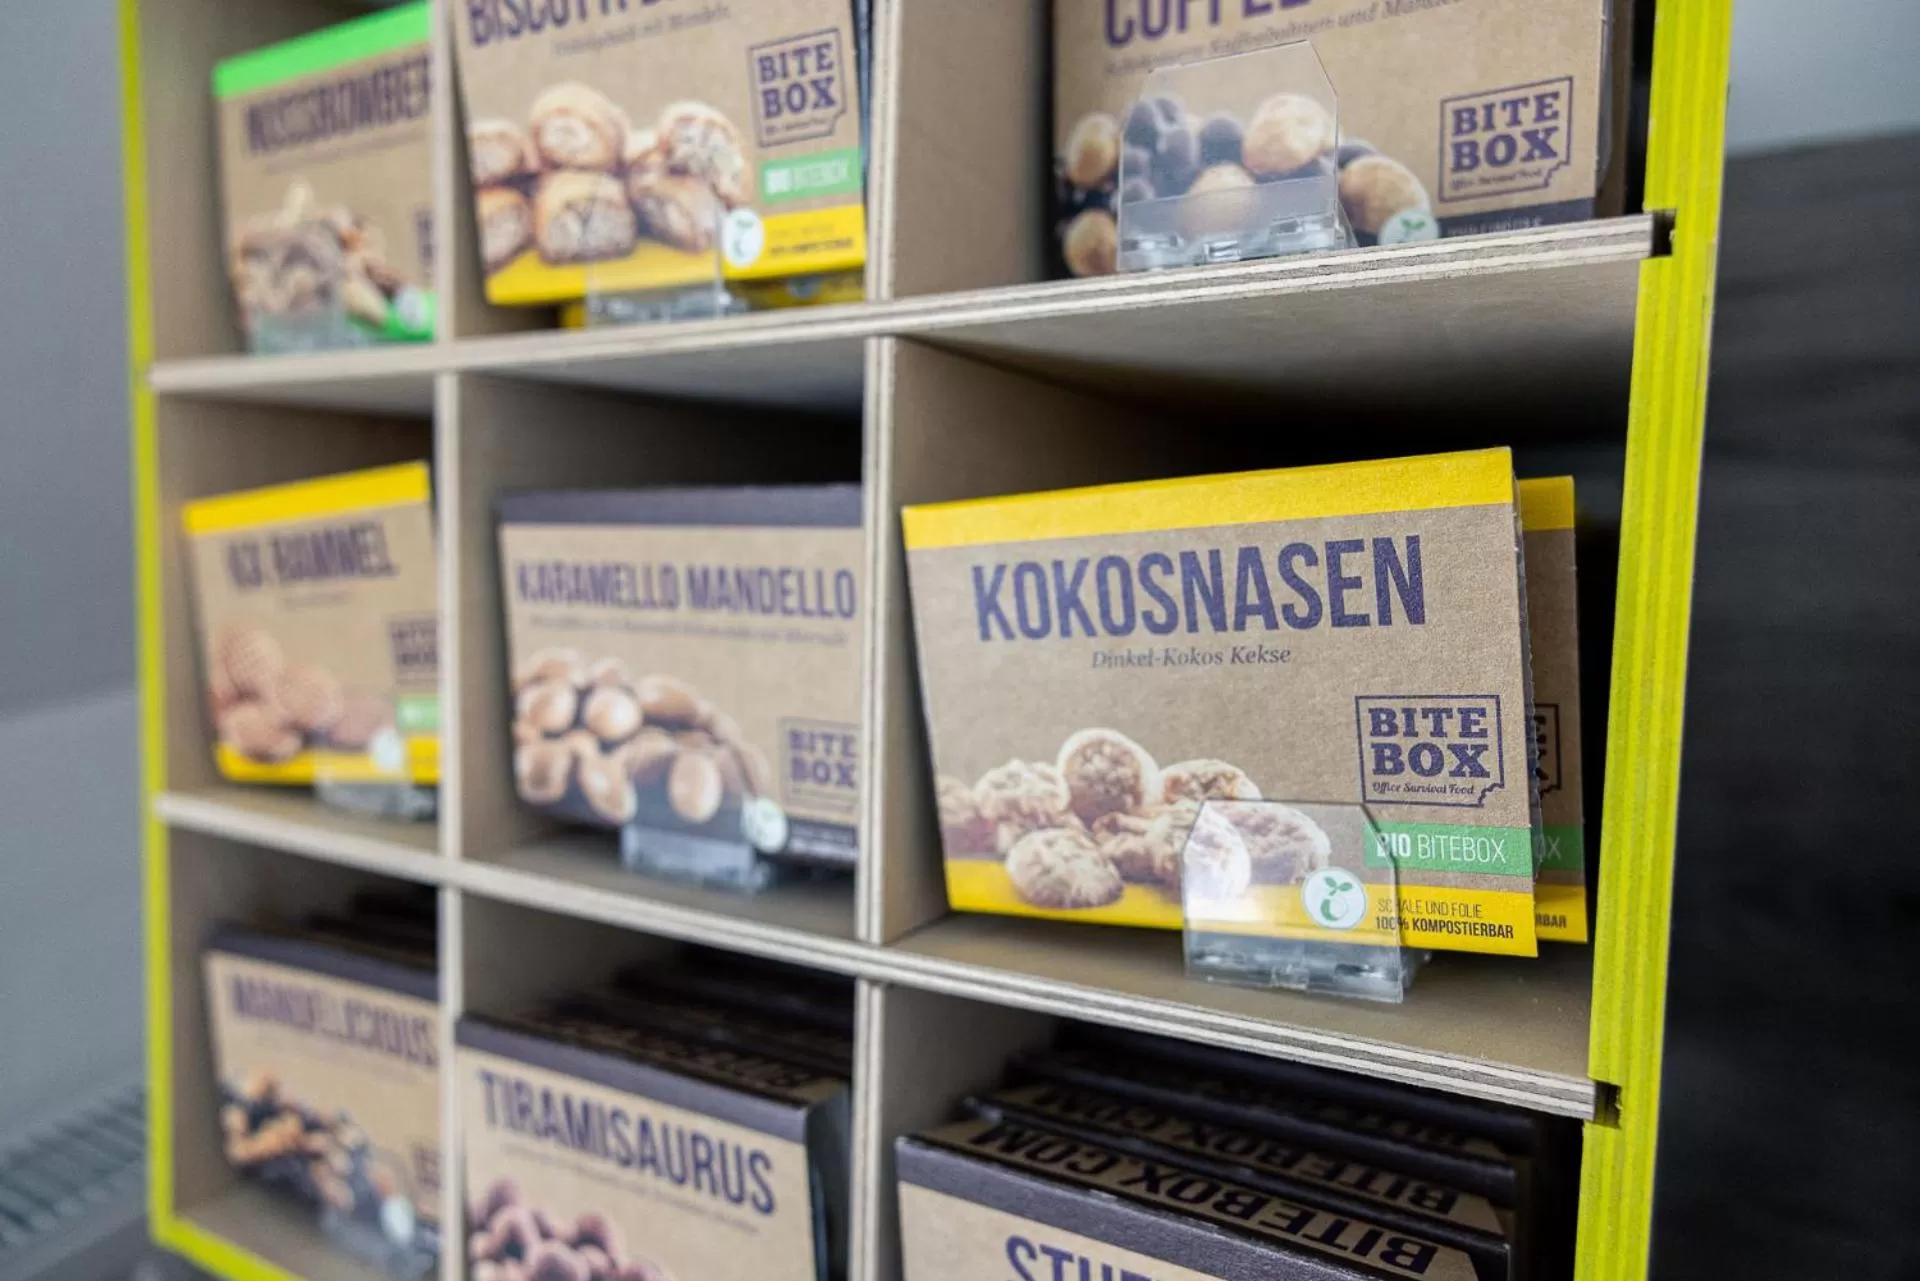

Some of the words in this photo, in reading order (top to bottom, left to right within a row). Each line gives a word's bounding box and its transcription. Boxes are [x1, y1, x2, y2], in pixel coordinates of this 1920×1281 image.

[757, 42, 834, 83] BITE
[762, 76, 836, 119] BOX
[1453, 91, 1560, 136] BITE
[1452, 126, 1559, 172] BOX
[686, 563, 857, 619] MANDELLO
[971, 535, 1426, 641] KOKOSNASEN
[1092, 646, 1224, 668] Dinkel-Kokos
[1230, 644, 1291, 664] Kekse
[1368, 707, 1488, 738] BITE
[791, 757, 856, 789] BOX
[1370, 742, 1491, 778] BOX
[1372, 782, 1400, 794] Office
[1403, 782, 1447, 793] Survival
[1448, 783, 1474, 794] Food
[1376, 833, 1411, 857] BIO
[1417, 834, 1507, 864] BITEBOX
[1378, 898, 1422, 915] SCALE
[1425, 900, 1449, 917] UND
[1451, 902, 1483, 919] FOLIE
[1412, 917, 1514, 939] KOMPOSTIERBAR
[479, 1067, 777, 1216] TIRAMISAURUS
